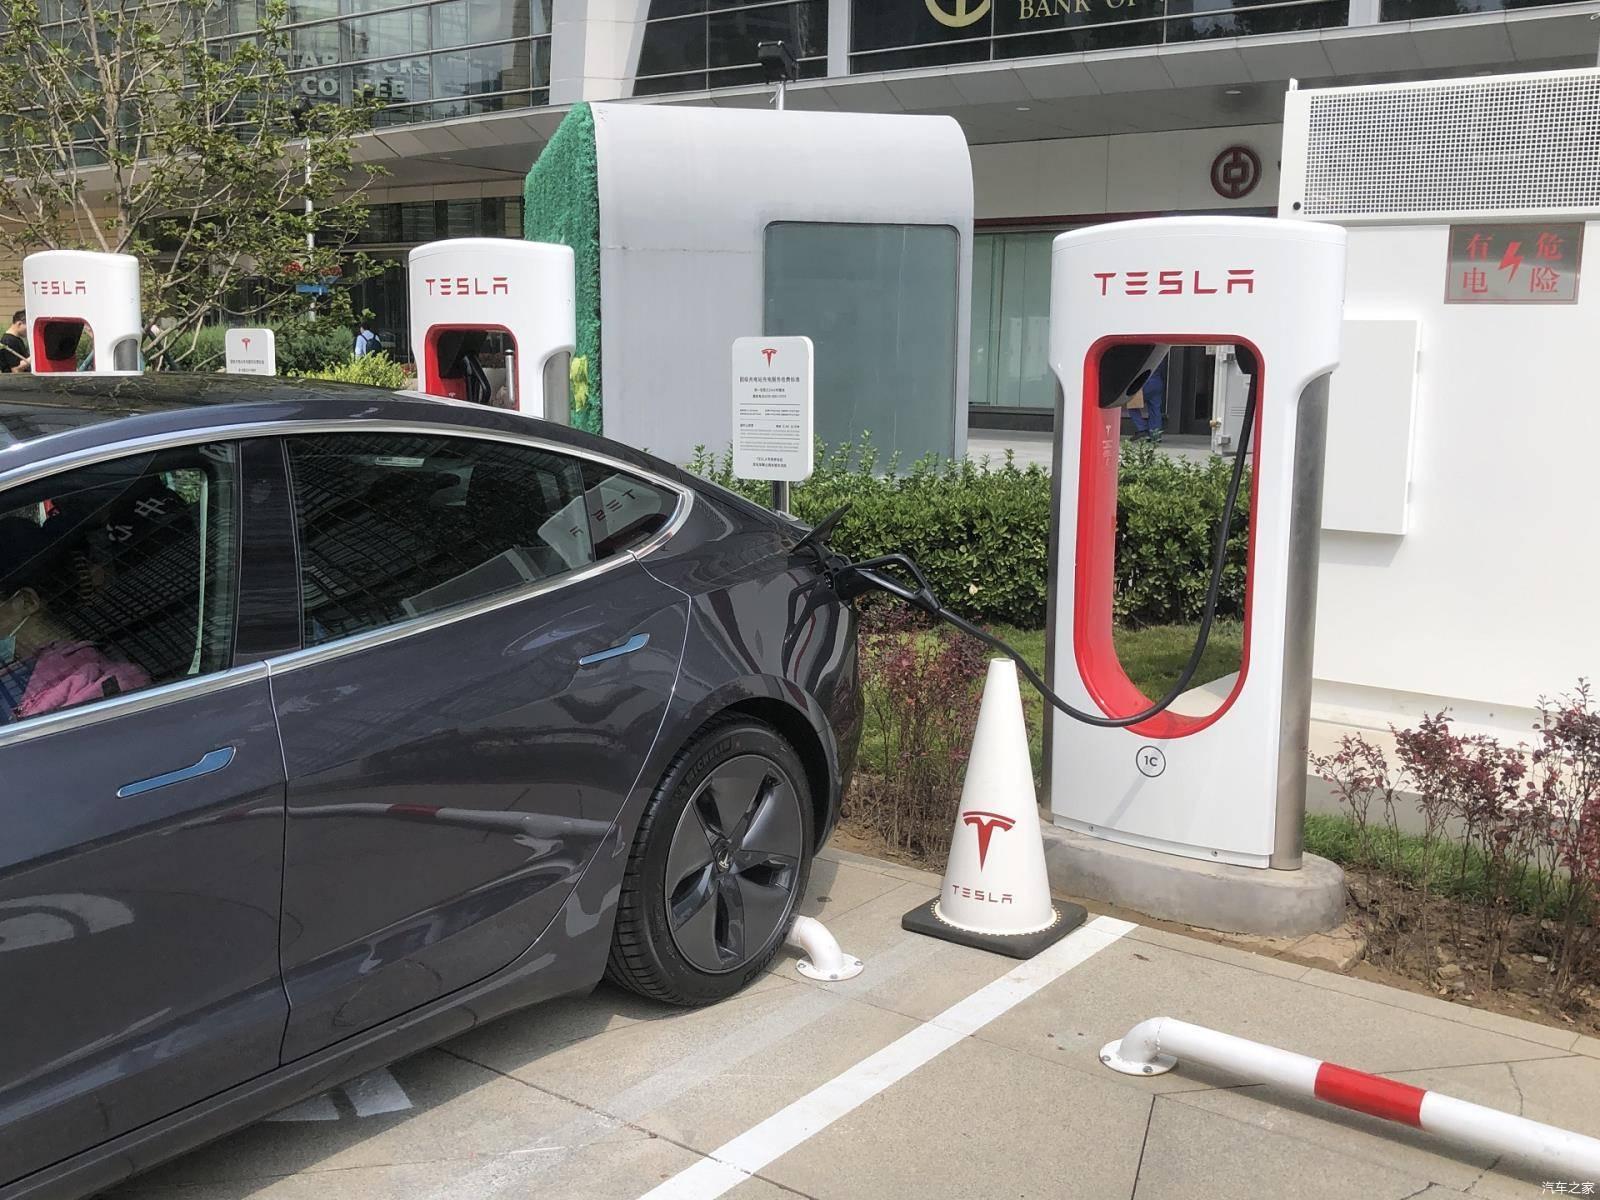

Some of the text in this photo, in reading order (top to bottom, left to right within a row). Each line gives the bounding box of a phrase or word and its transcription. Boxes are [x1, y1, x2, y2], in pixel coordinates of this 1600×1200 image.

[1018, 0, 1091, 20] BANK
[32, 280, 86, 295] TESLA
[425, 276, 509, 296] TESLA
[1093, 268, 1255, 296] TESLA
[1144, 755, 1158, 767] 1C
[952, 884, 1013, 905] TESLA
